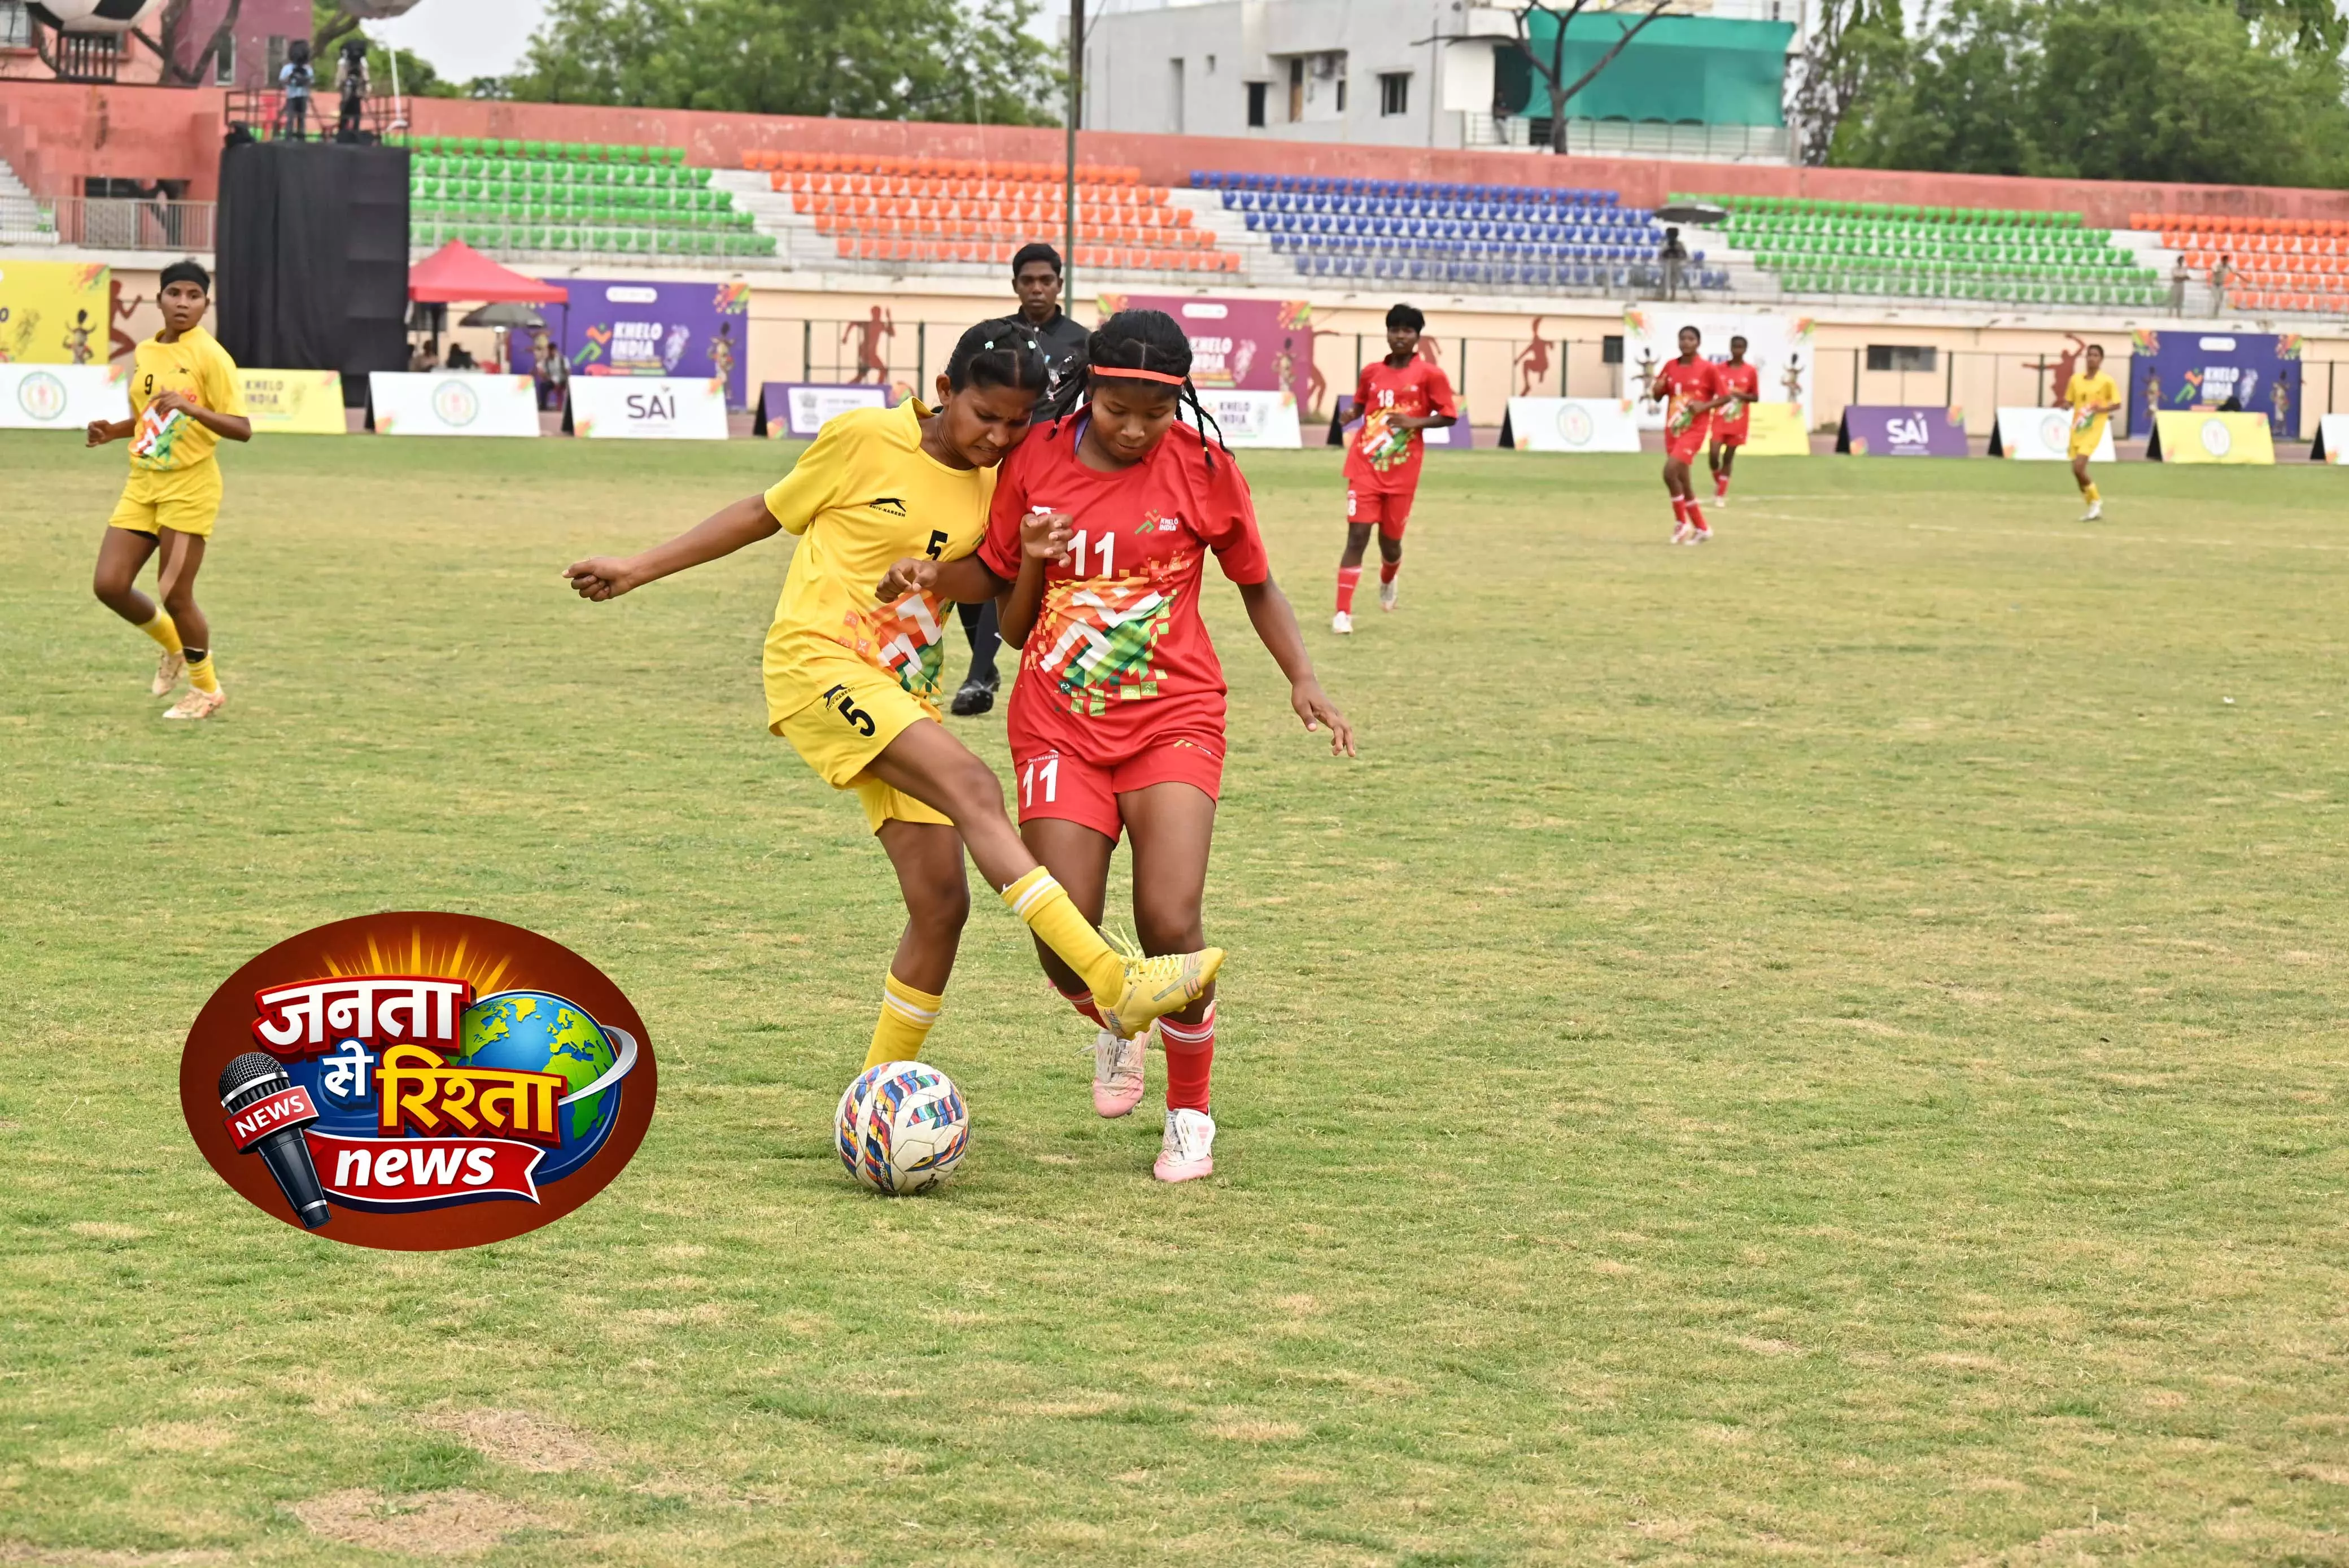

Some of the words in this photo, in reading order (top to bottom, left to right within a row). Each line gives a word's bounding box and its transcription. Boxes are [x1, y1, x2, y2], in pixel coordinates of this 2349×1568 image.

[613, 321, 663, 340] KHELO
[1190, 353, 1225, 373] NDIA
[145, 374, 153, 395] 9
[1377, 389, 1394, 407] 18
[925, 529, 948, 561] 5
[1067, 529, 1115, 579] 11
[838, 695, 875, 737] 5
[1023, 759, 1058, 807] 11
